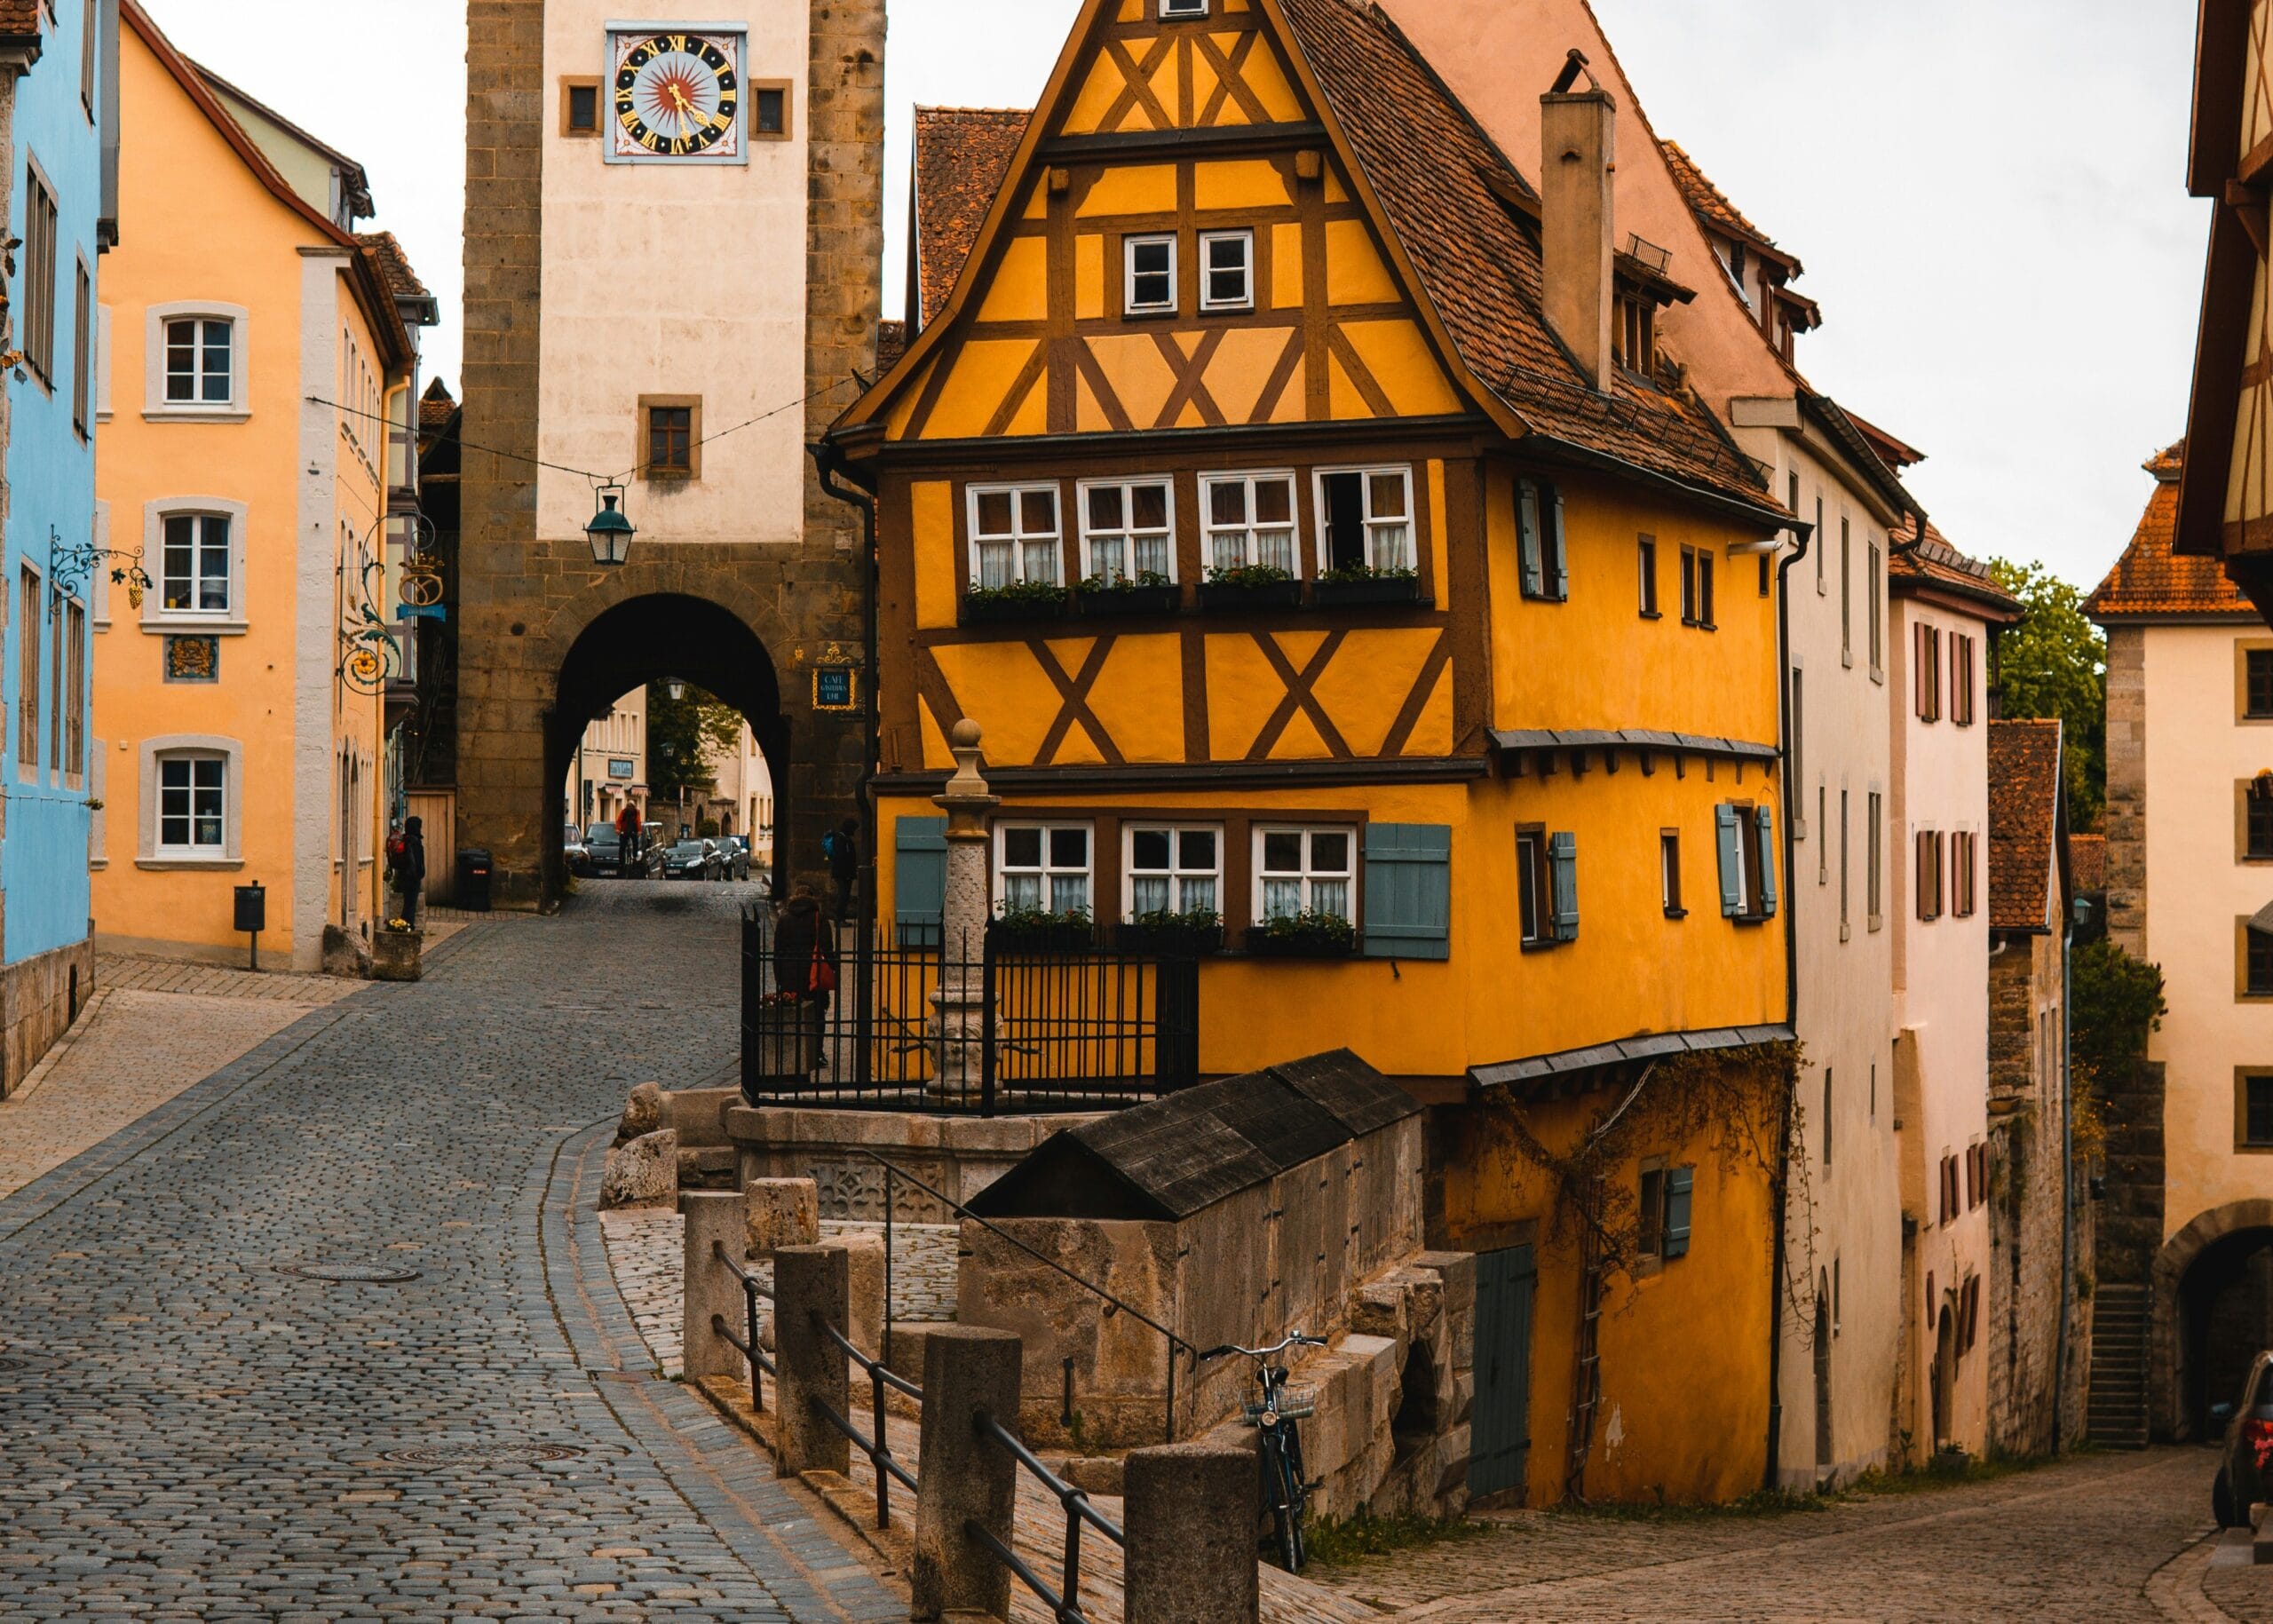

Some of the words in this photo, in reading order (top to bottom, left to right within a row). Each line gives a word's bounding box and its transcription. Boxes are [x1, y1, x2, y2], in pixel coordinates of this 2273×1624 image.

[640, 40, 661, 59] XI
[667, 36, 686, 51] XII
[697, 43, 709, 57] I
[622, 60, 641, 75] X
[714, 62, 731, 76] II
[616, 88, 633, 102] IX
[721, 89, 736, 102] III
[620, 111, 640, 131] VIII
[639, 131, 658, 150] VII
[670, 139, 685, 154] VI
[698, 135, 711, 149] V
